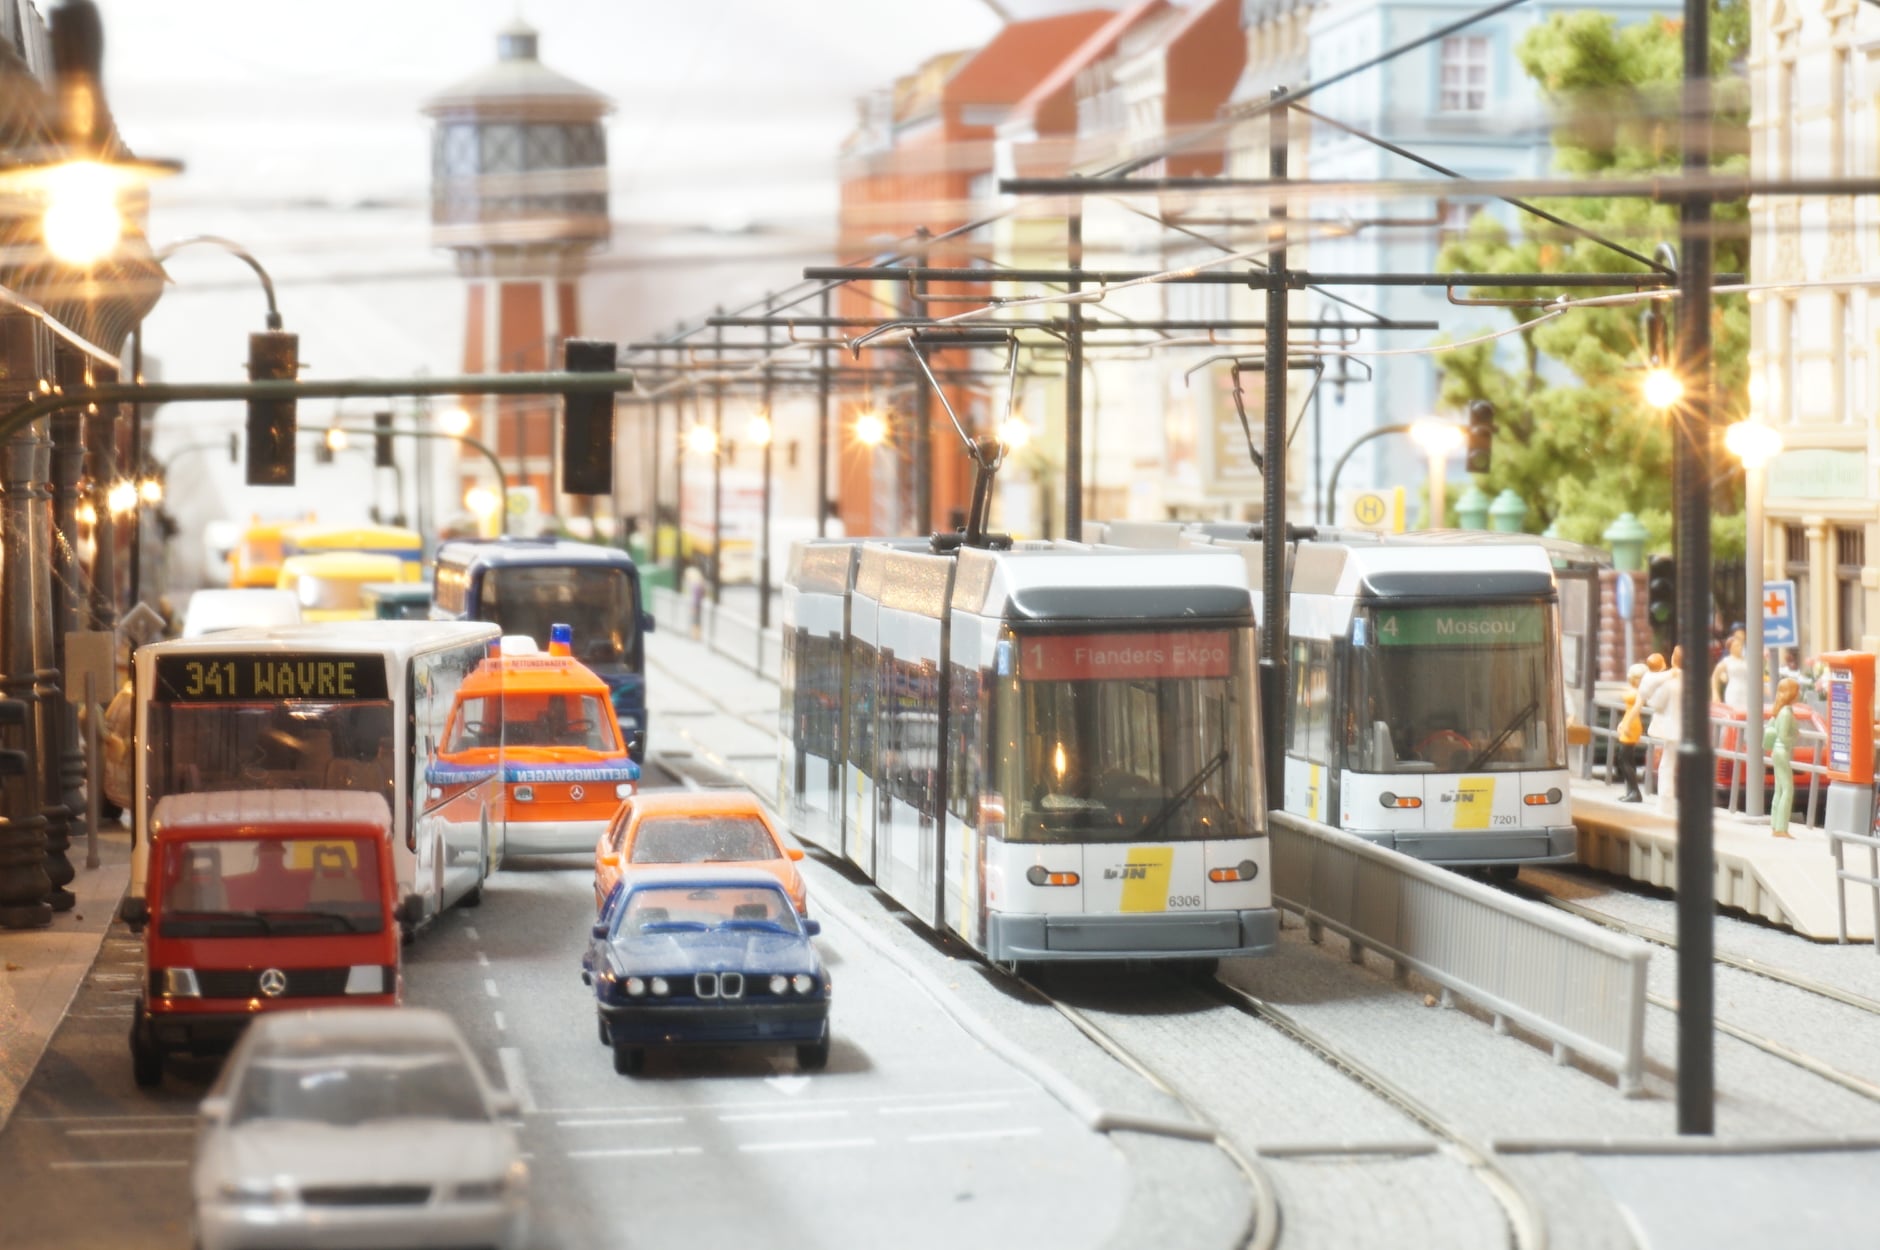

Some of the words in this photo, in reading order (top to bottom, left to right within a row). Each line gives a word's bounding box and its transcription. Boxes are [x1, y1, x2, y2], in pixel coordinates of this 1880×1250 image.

[1363, 501, 1377, 519] H
[1383, 615, 1399, 637] 4
[1435, 617, 1516, 635] Moscou
[1030, 643, 1043, 671] 1
[1074, 647, 1165, 666] Flanders
[1171, 644, 1225, 664] Expo
[185, 661, 236, 696] 341
[253, 661, 356, 696] WAVRE
[1492, 815, 1517, 825] 7201
[1168, 895, 1201, 908] 6306
